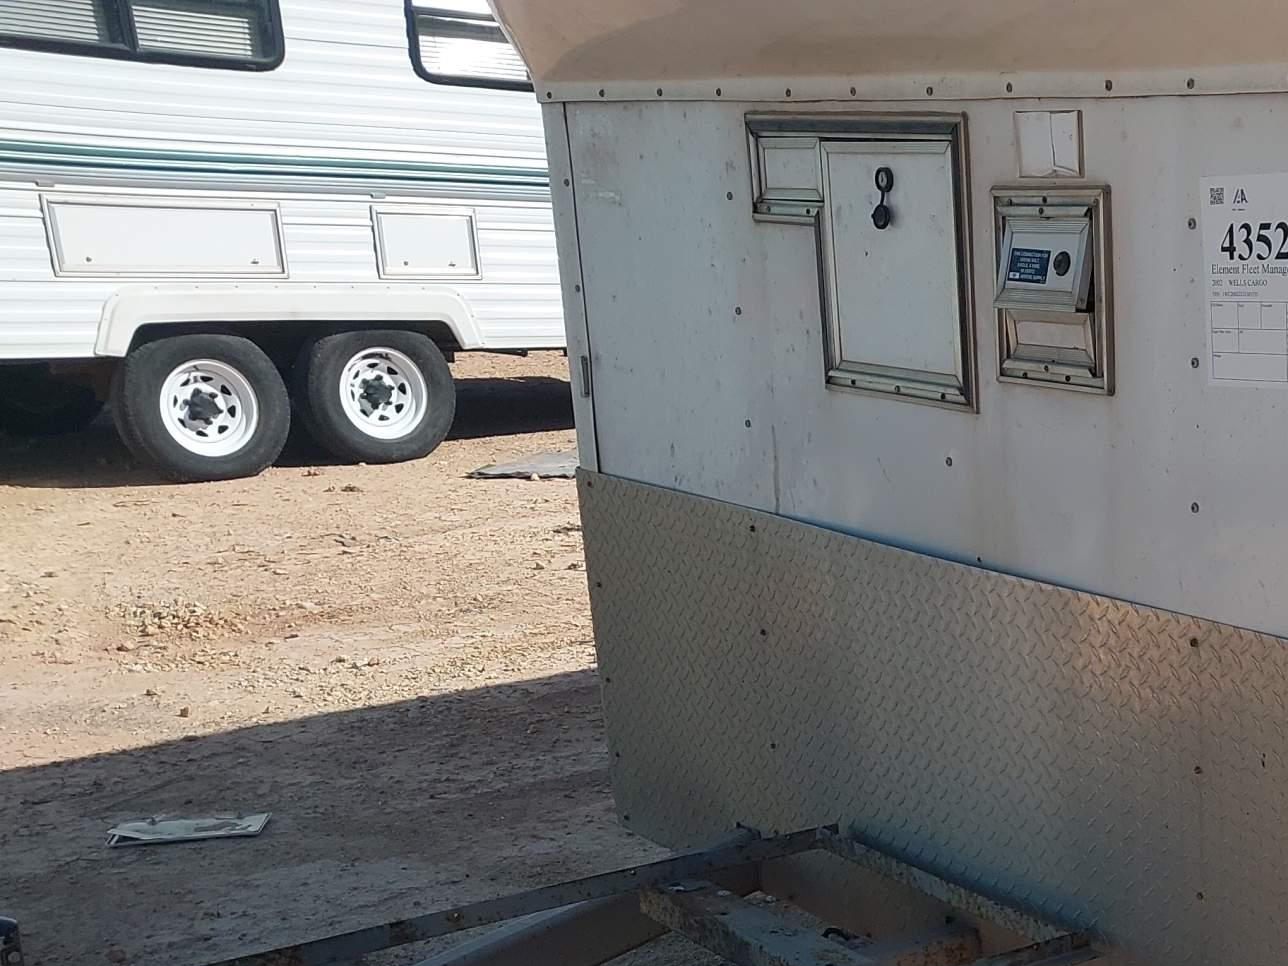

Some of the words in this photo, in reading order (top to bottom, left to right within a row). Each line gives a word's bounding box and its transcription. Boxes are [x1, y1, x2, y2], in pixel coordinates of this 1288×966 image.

[1211, 264, 1240, 275] Element
[1242, 264, 1260, 275] Fleet
[1228, 279, 1247, 287] WELLS
[1247, 279, 1268, 287] CARGO
